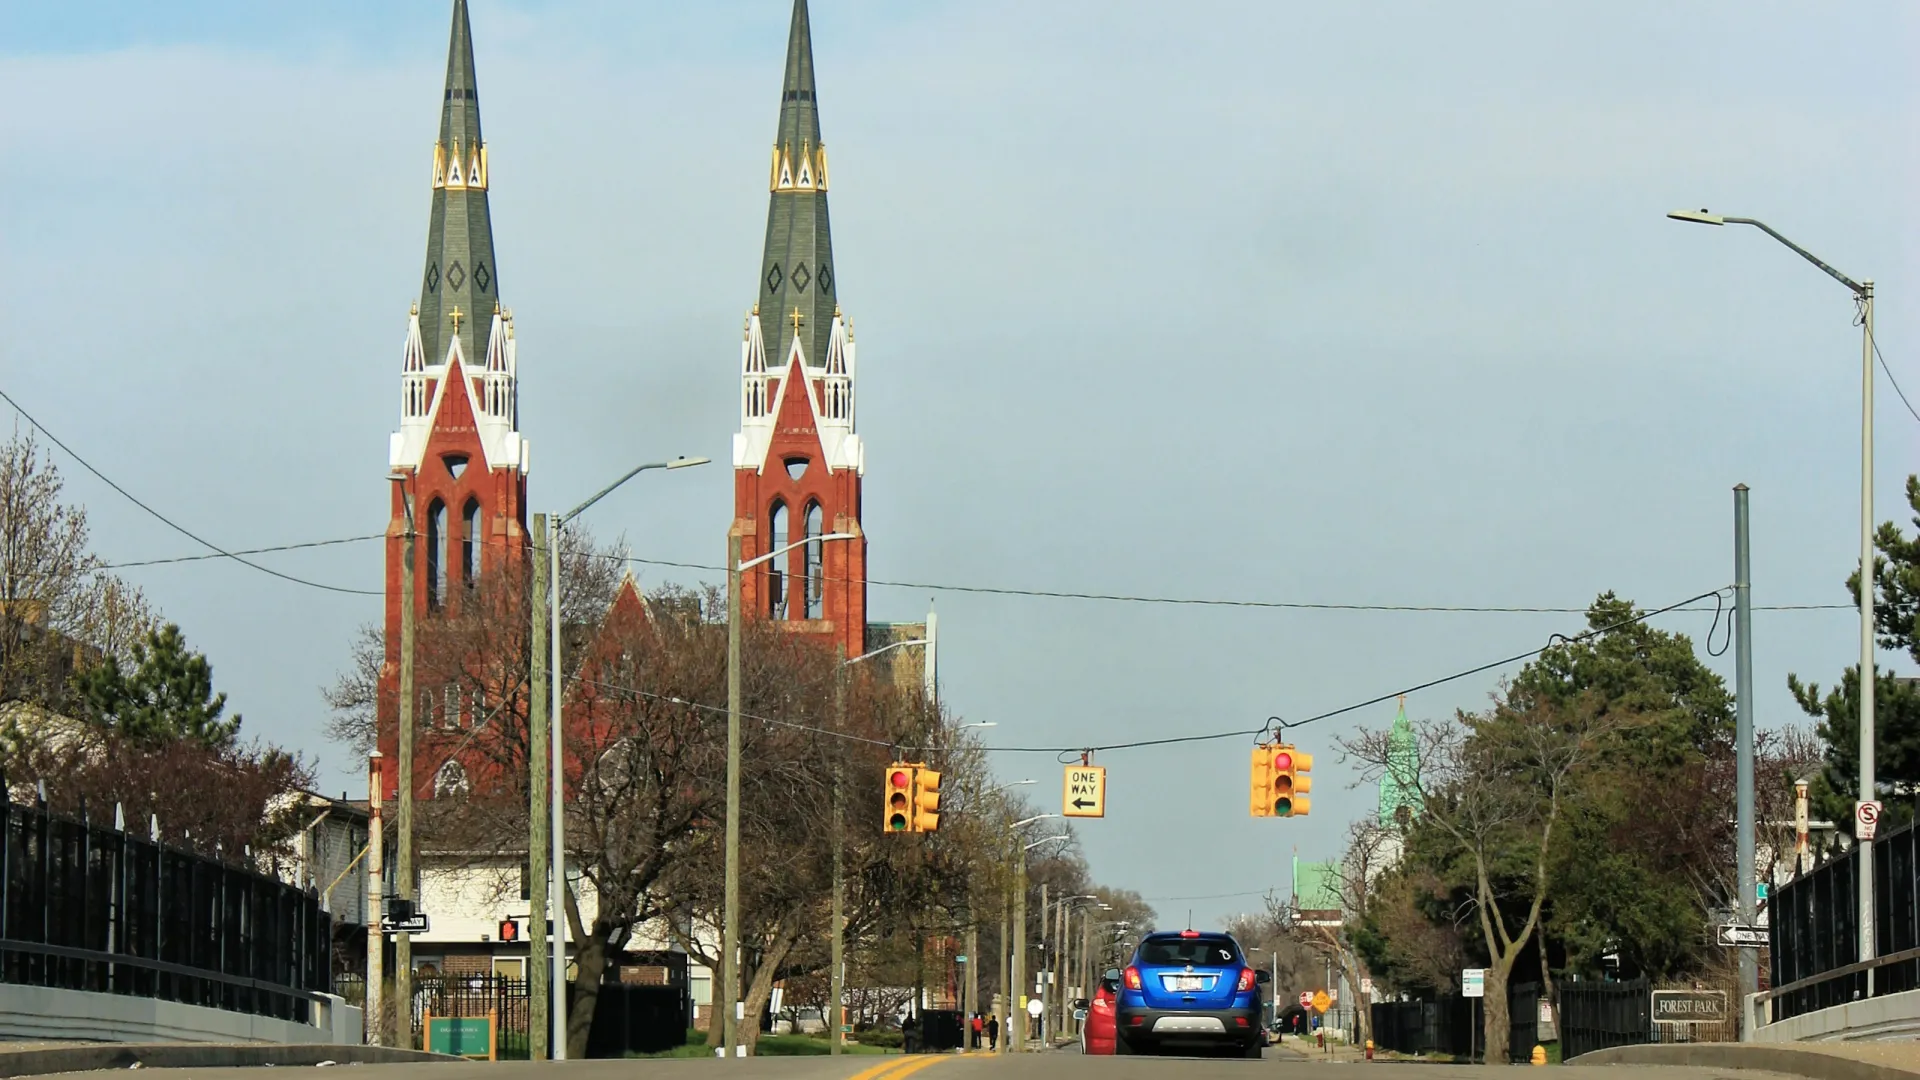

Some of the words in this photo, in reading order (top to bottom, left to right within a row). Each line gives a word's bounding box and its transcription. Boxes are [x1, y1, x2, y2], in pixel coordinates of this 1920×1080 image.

[1072, 772, 1096, 783] ONE
[1071, 784, 1096, 795] WAY
[1736, 932, 1752, 940] ONE
[1659, 1000, 1693, 1013] FOREST
[1694, 1000, 1719, 1013] PARK
